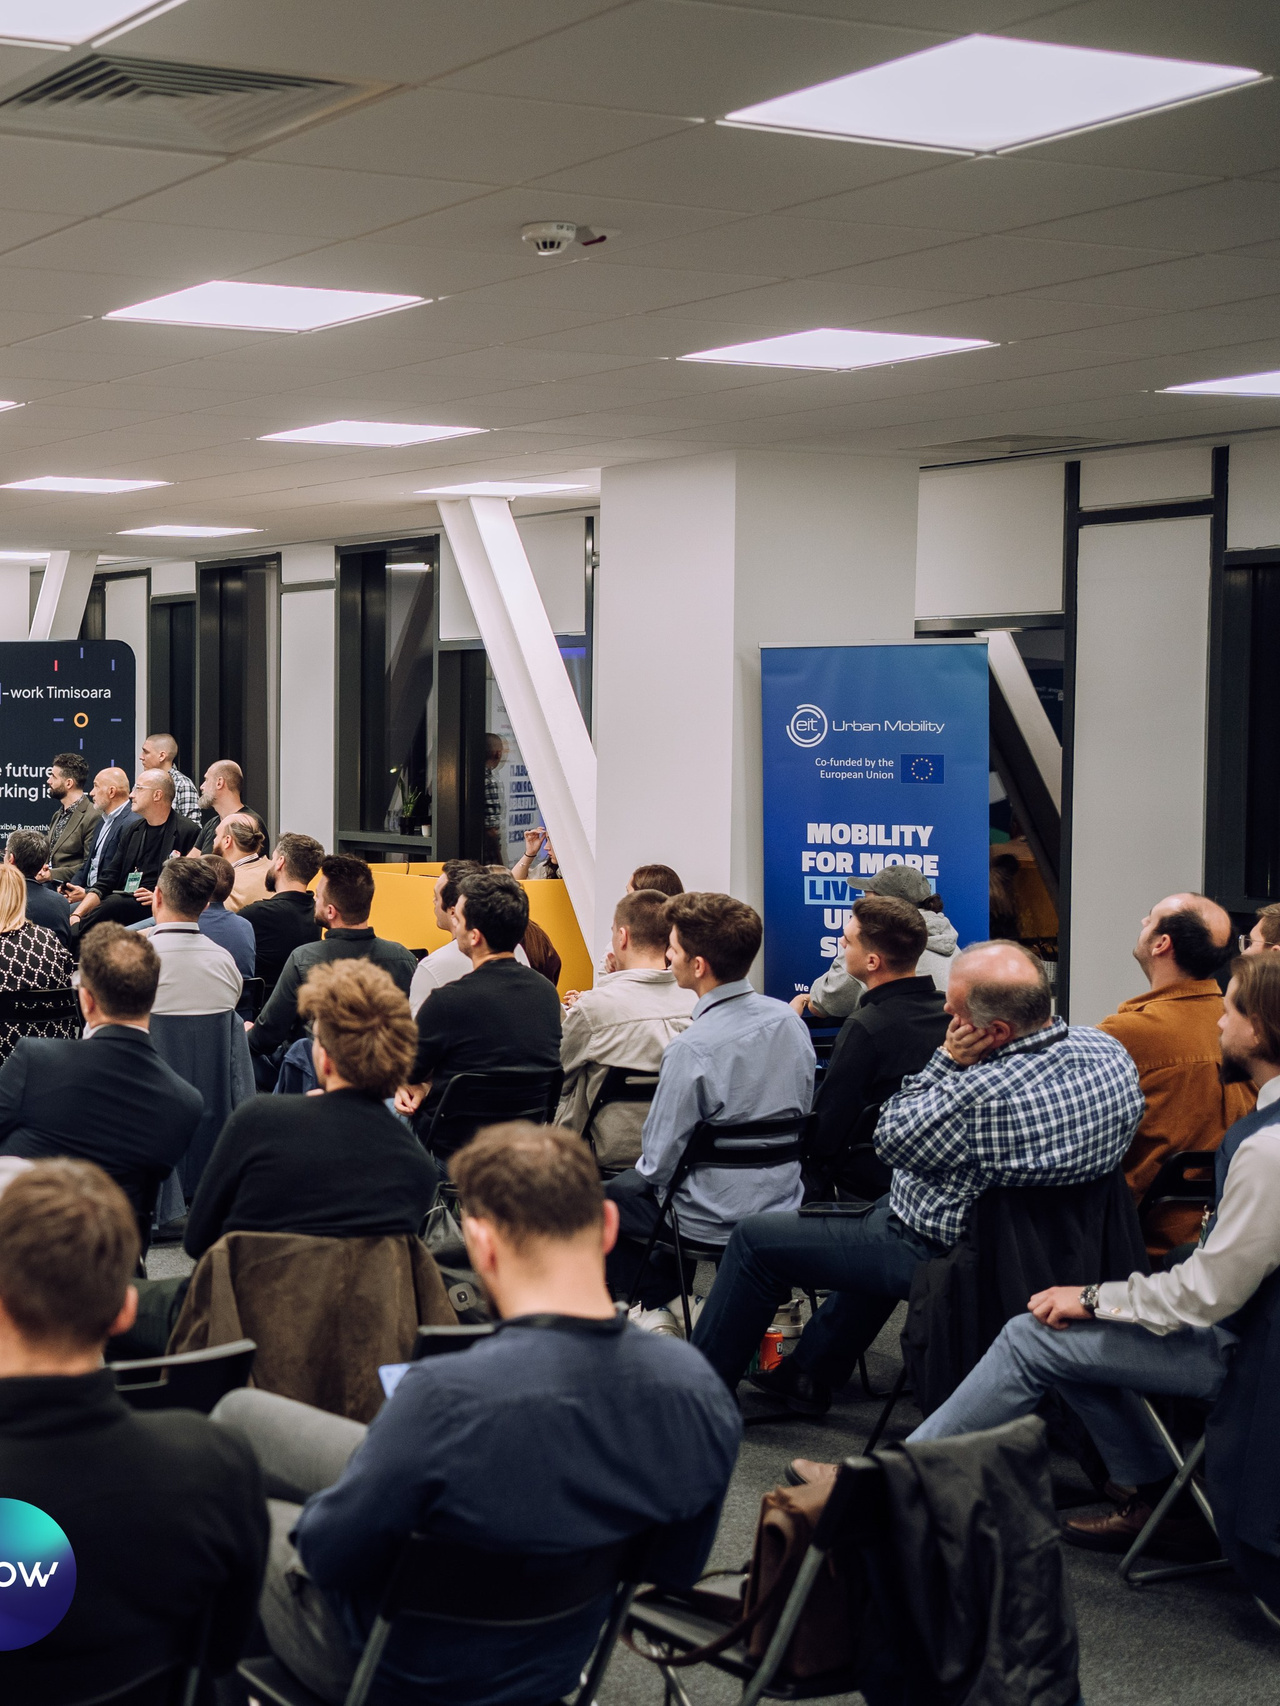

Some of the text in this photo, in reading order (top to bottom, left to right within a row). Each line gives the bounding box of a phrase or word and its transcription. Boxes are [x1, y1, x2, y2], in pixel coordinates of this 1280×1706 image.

[47, 686, 111, 699] Timisoara
[796, 718, 945, 734] eit Urban Mobility
[5, 763, 53, 777] future
[815, 757, 894, 769] Co-funded by the
[820, 769, 894, 780] European Union
[807, 823, 933, 847] MOBILITY
[802, 851, 939, 876] FOR MORE
[809, 879, 866, 901] LIVE
[795, 983, 809, 992] We
